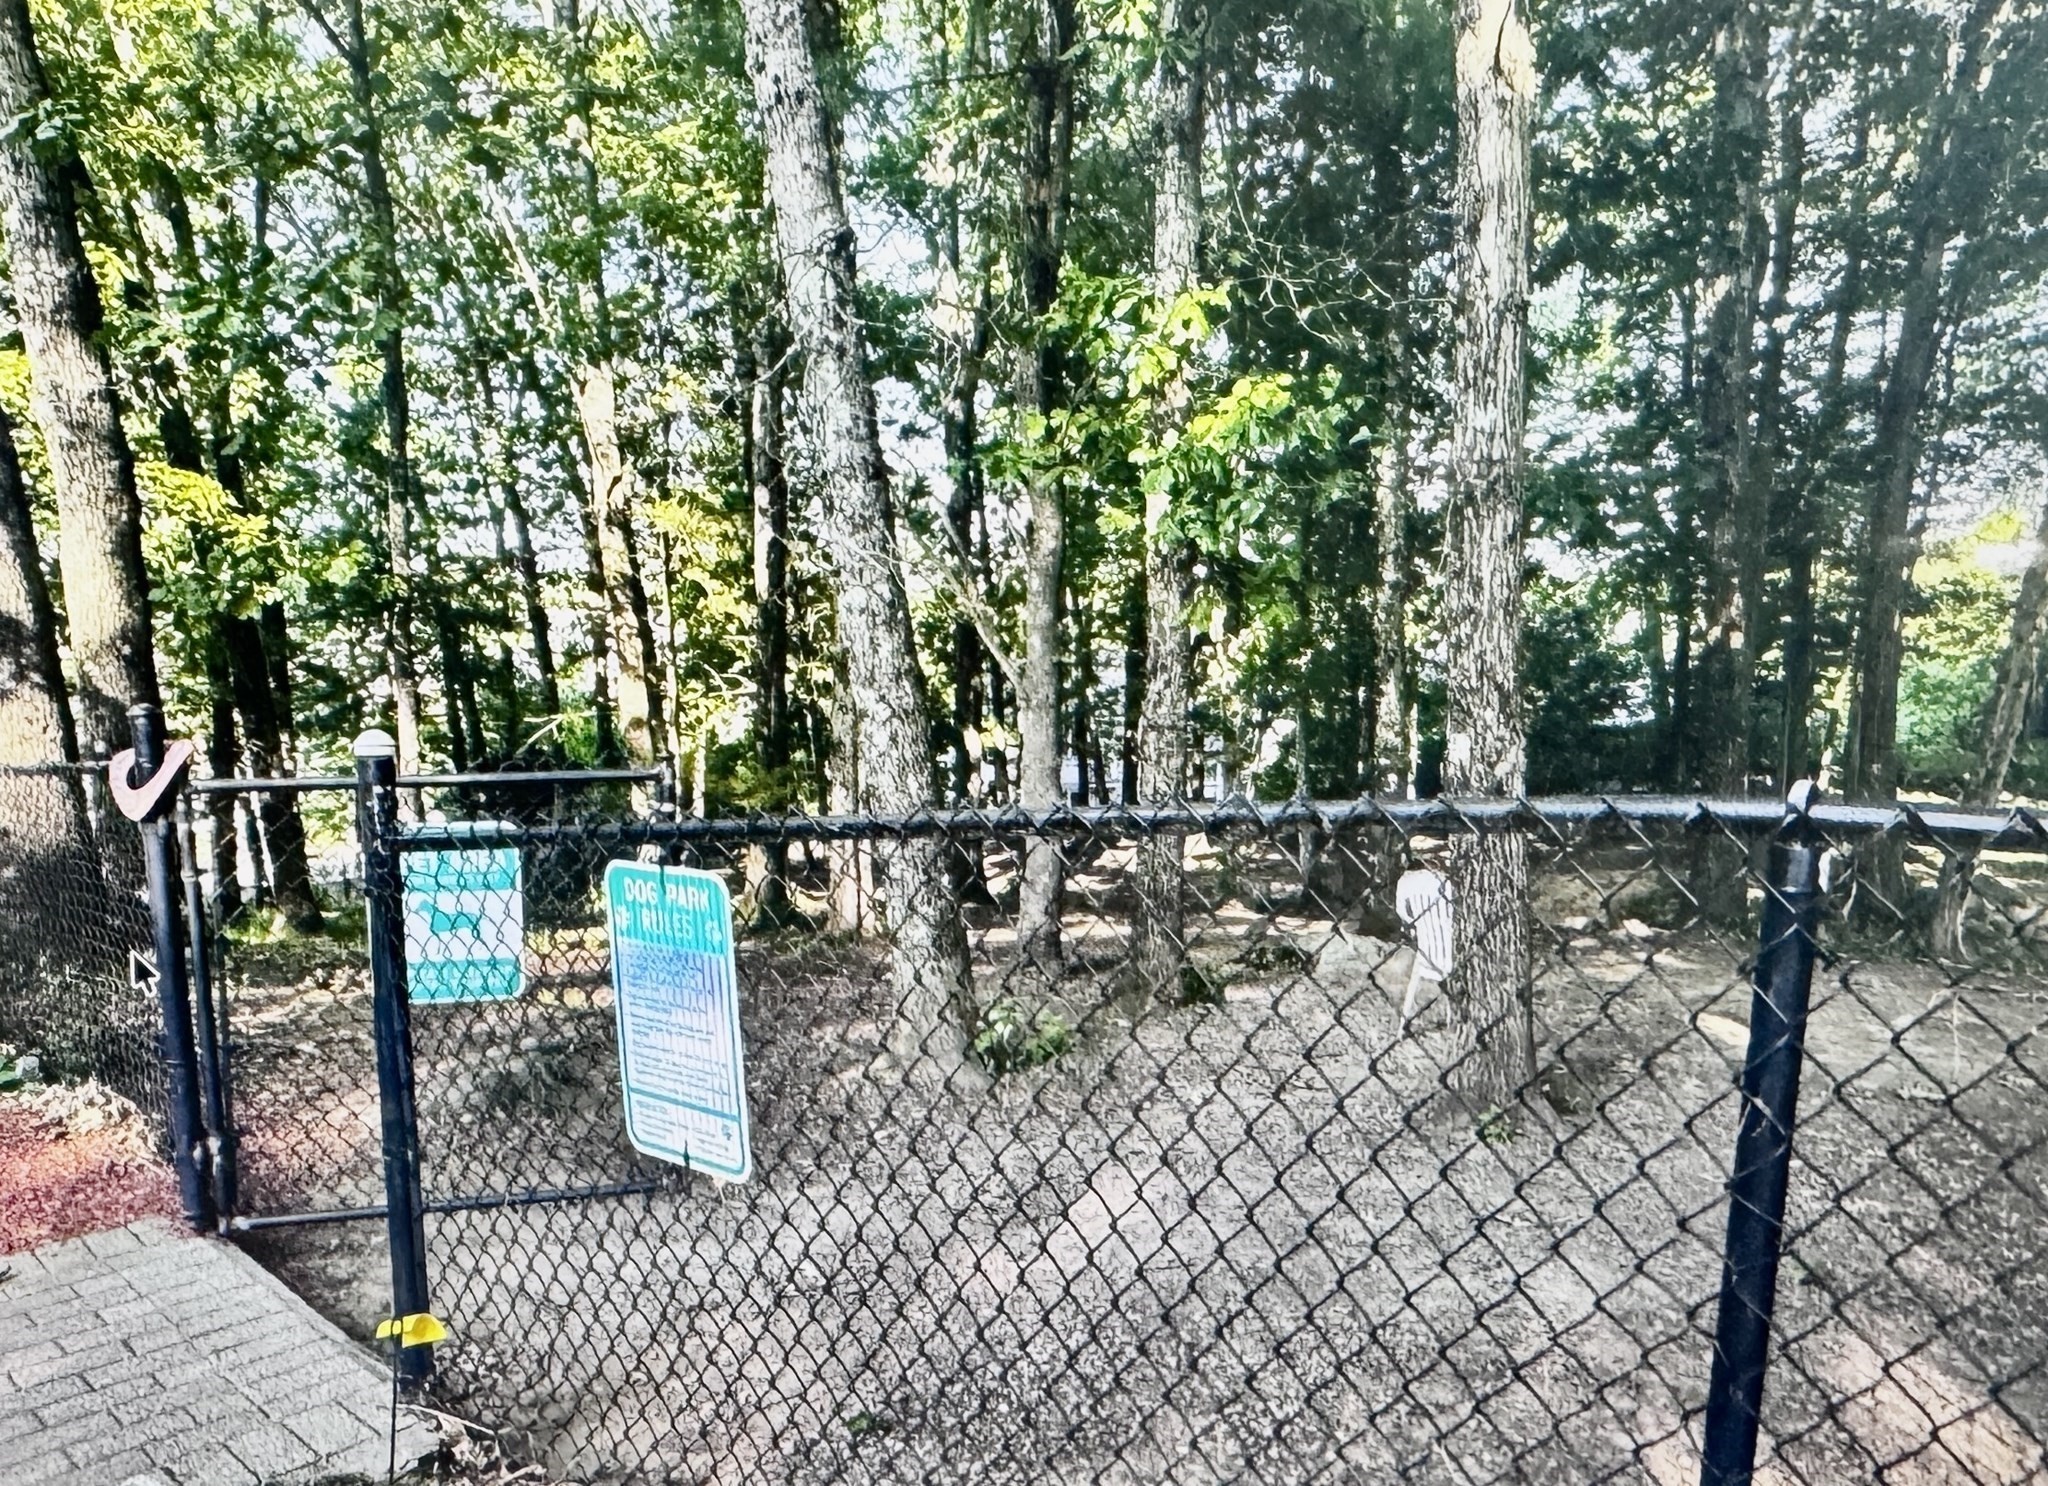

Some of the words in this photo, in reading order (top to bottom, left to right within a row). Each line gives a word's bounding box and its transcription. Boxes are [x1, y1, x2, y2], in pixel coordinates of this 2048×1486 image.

[623, 877, 659, 905] DOG
[665, 883, 711, 912] PARK
[641, 906, 695, 940] RULES
